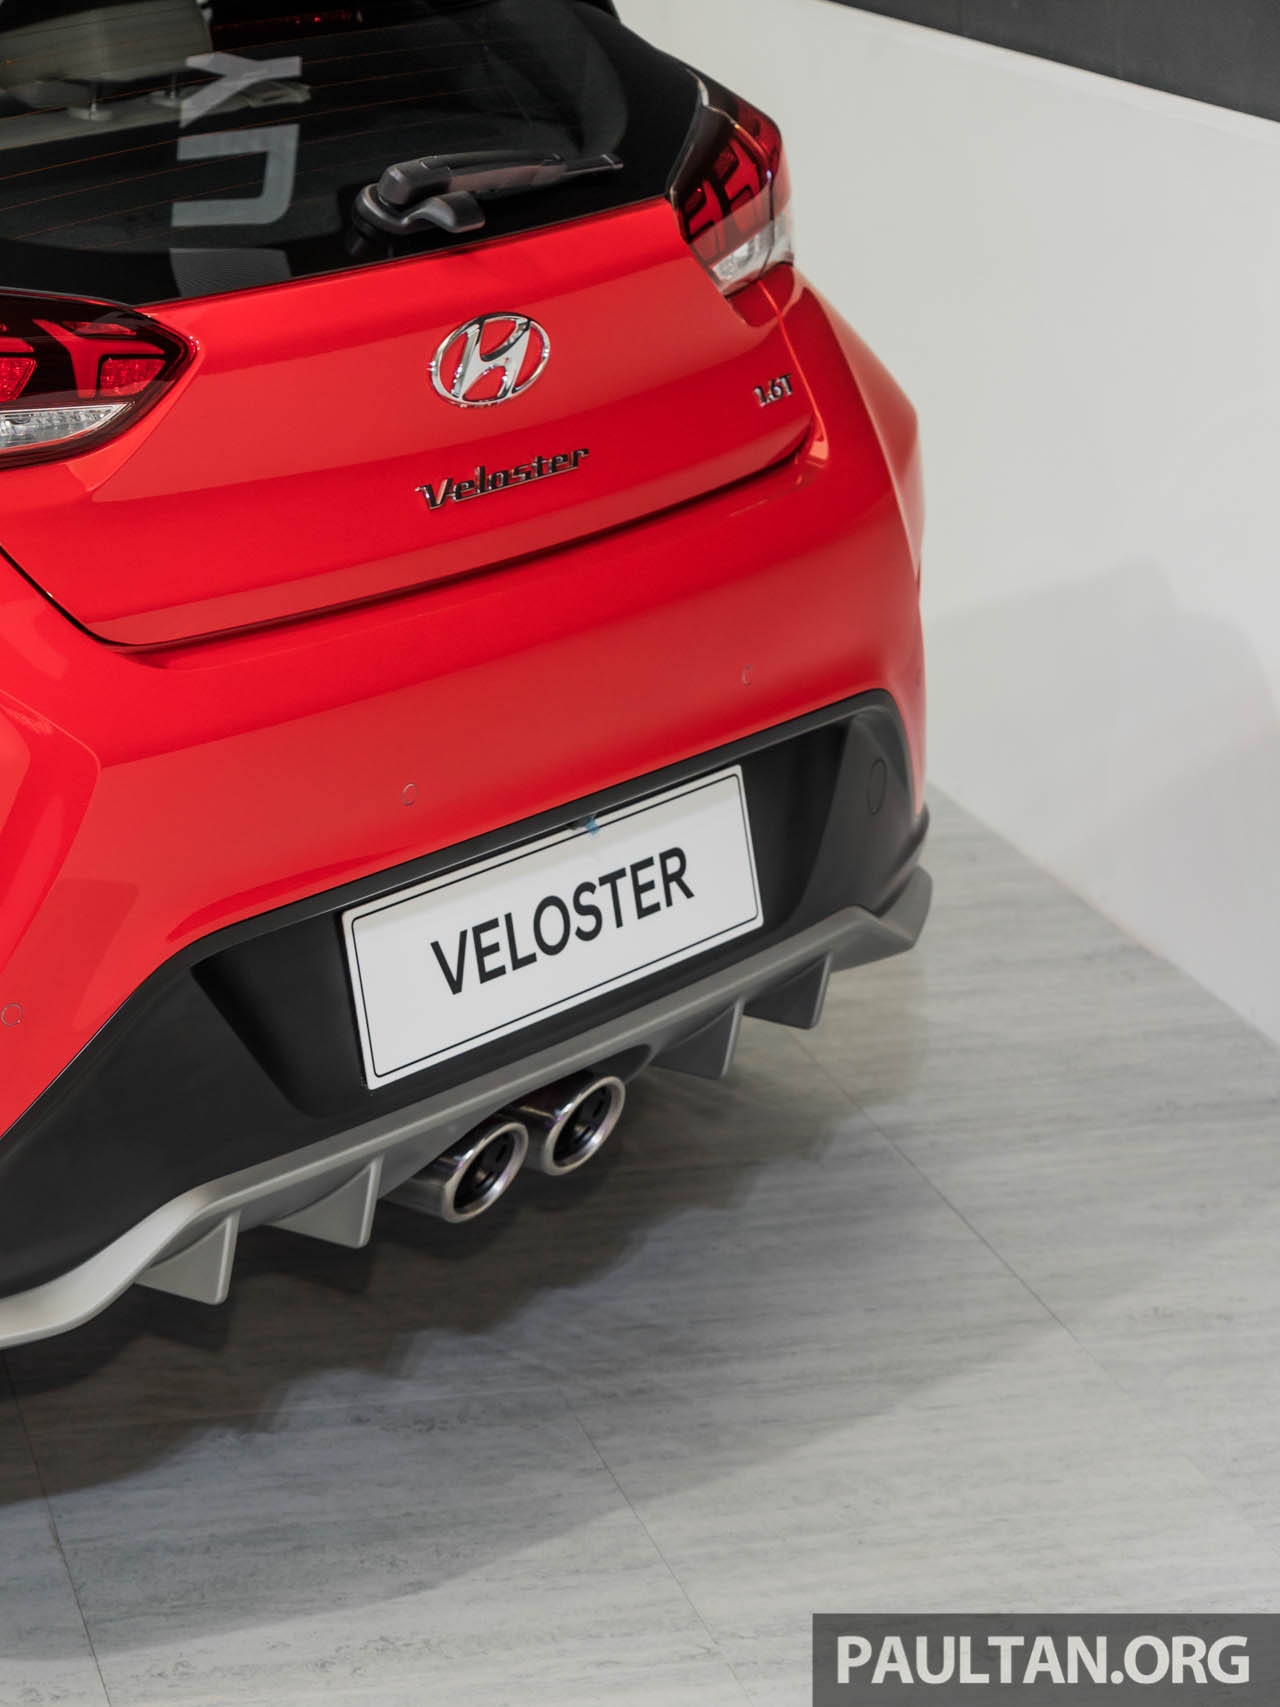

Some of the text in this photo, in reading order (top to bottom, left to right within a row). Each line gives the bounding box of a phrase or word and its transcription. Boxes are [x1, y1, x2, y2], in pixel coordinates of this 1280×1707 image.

[753, 373, 792, 407] 1.6T
[415, 447, 589, 510] Veloster
[430, 847, 695, 995] VELOSTER
